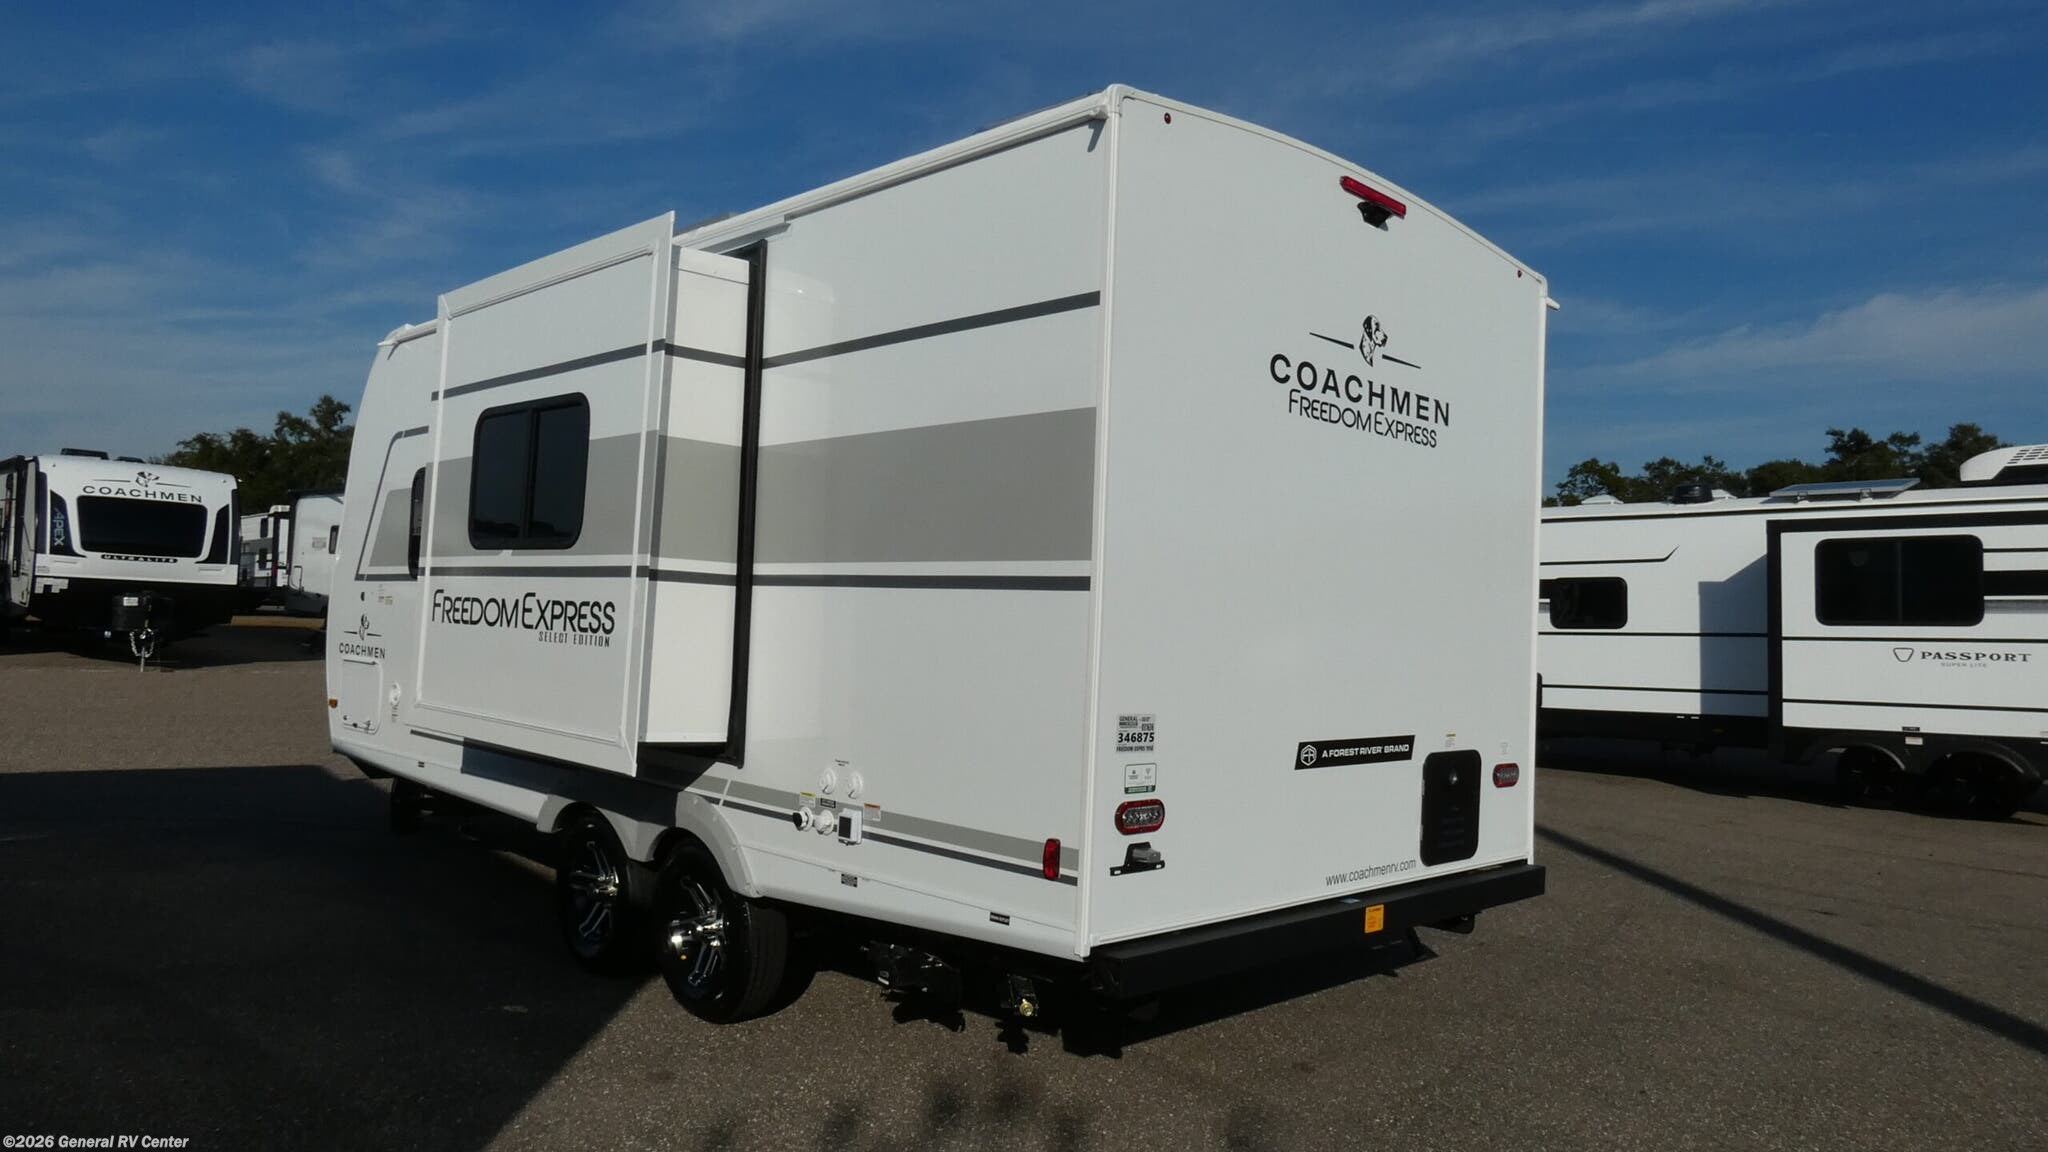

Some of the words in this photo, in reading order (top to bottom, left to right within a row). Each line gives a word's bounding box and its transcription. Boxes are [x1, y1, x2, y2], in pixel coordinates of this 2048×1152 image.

[1270, 354, 1449, 426] COACHMEN
[83, 485, 202, 503] COACHMEN
[538, 630, 568, 645] SELECT
[572, 633, 611, 648] EDITION
[338, 642, 386, 660] COACHMEN
[1921, 651, 2032, 662] PASSPORT
[1118, 732, 1154, 743] 346875
[1321, 750, 1329, 759] A
[1328, 747, 1360, 758] FOREST
[1359, 745, 1383, 756] RIVER
[1383, 743, 1410, 754] BRAND
[1325, 859, 1416, 886] www.coachmenrv.com
